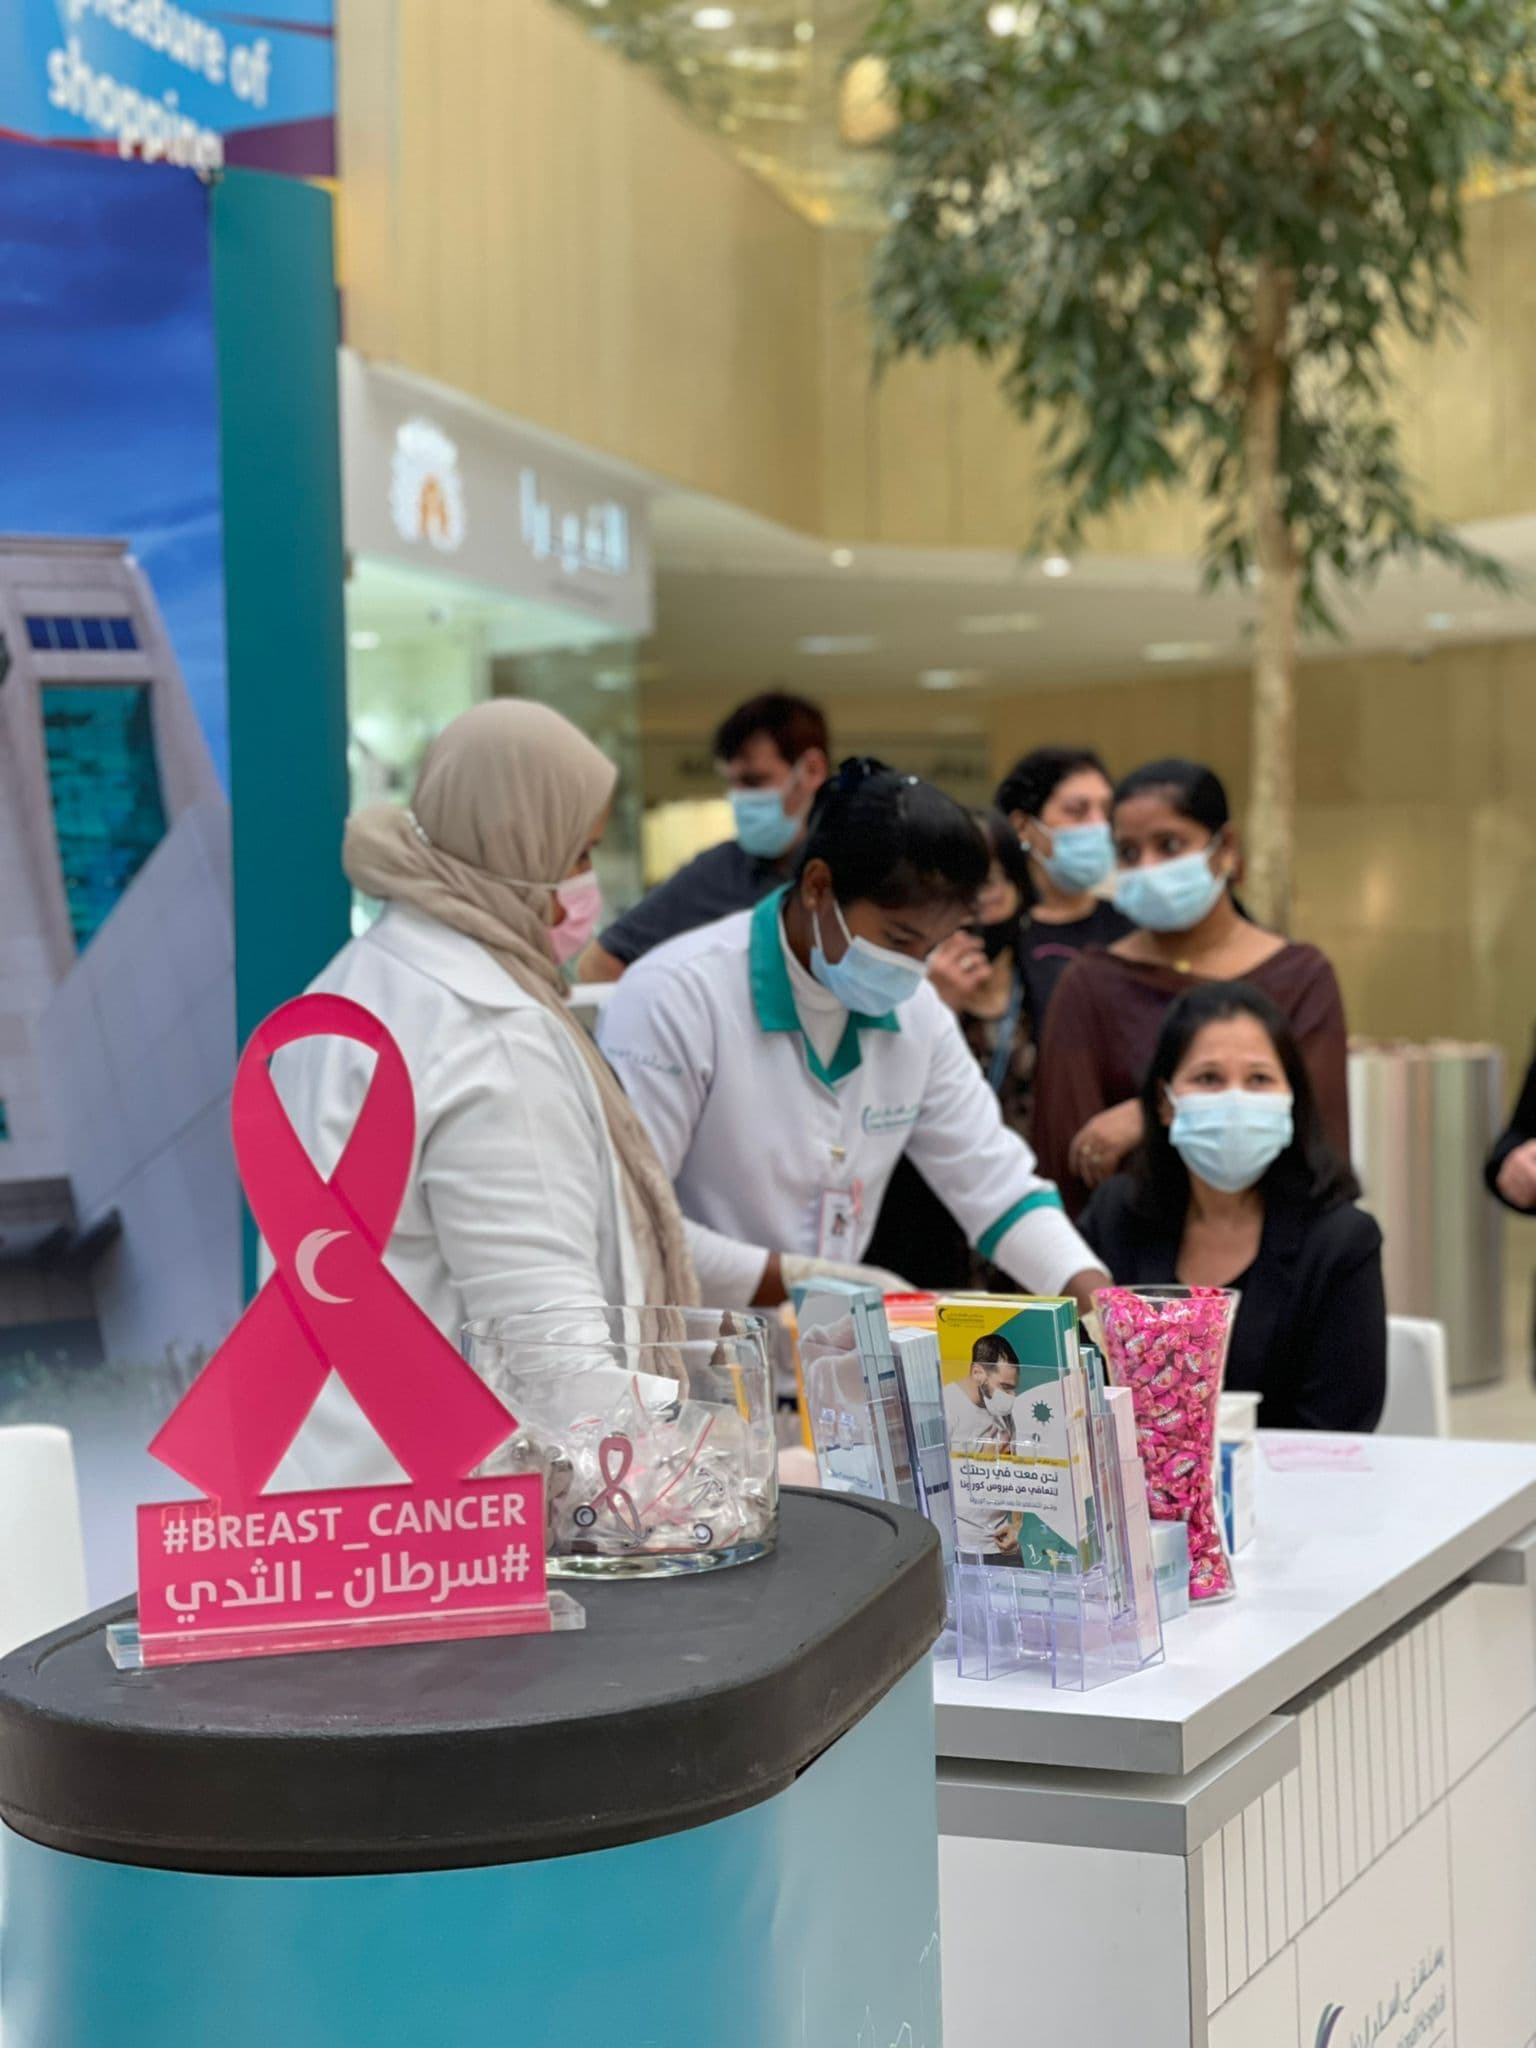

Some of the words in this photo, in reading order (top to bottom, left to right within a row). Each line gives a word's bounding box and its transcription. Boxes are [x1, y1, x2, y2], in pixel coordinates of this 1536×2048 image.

[229, 38, 271, 110] of
[992, 1466, 1011, 1480] في
[960, 1480, 985, 1491] كورونا
[986, 1481, 1014, 1492] فيروس
[1015, 1483, 1027, 1494] من
